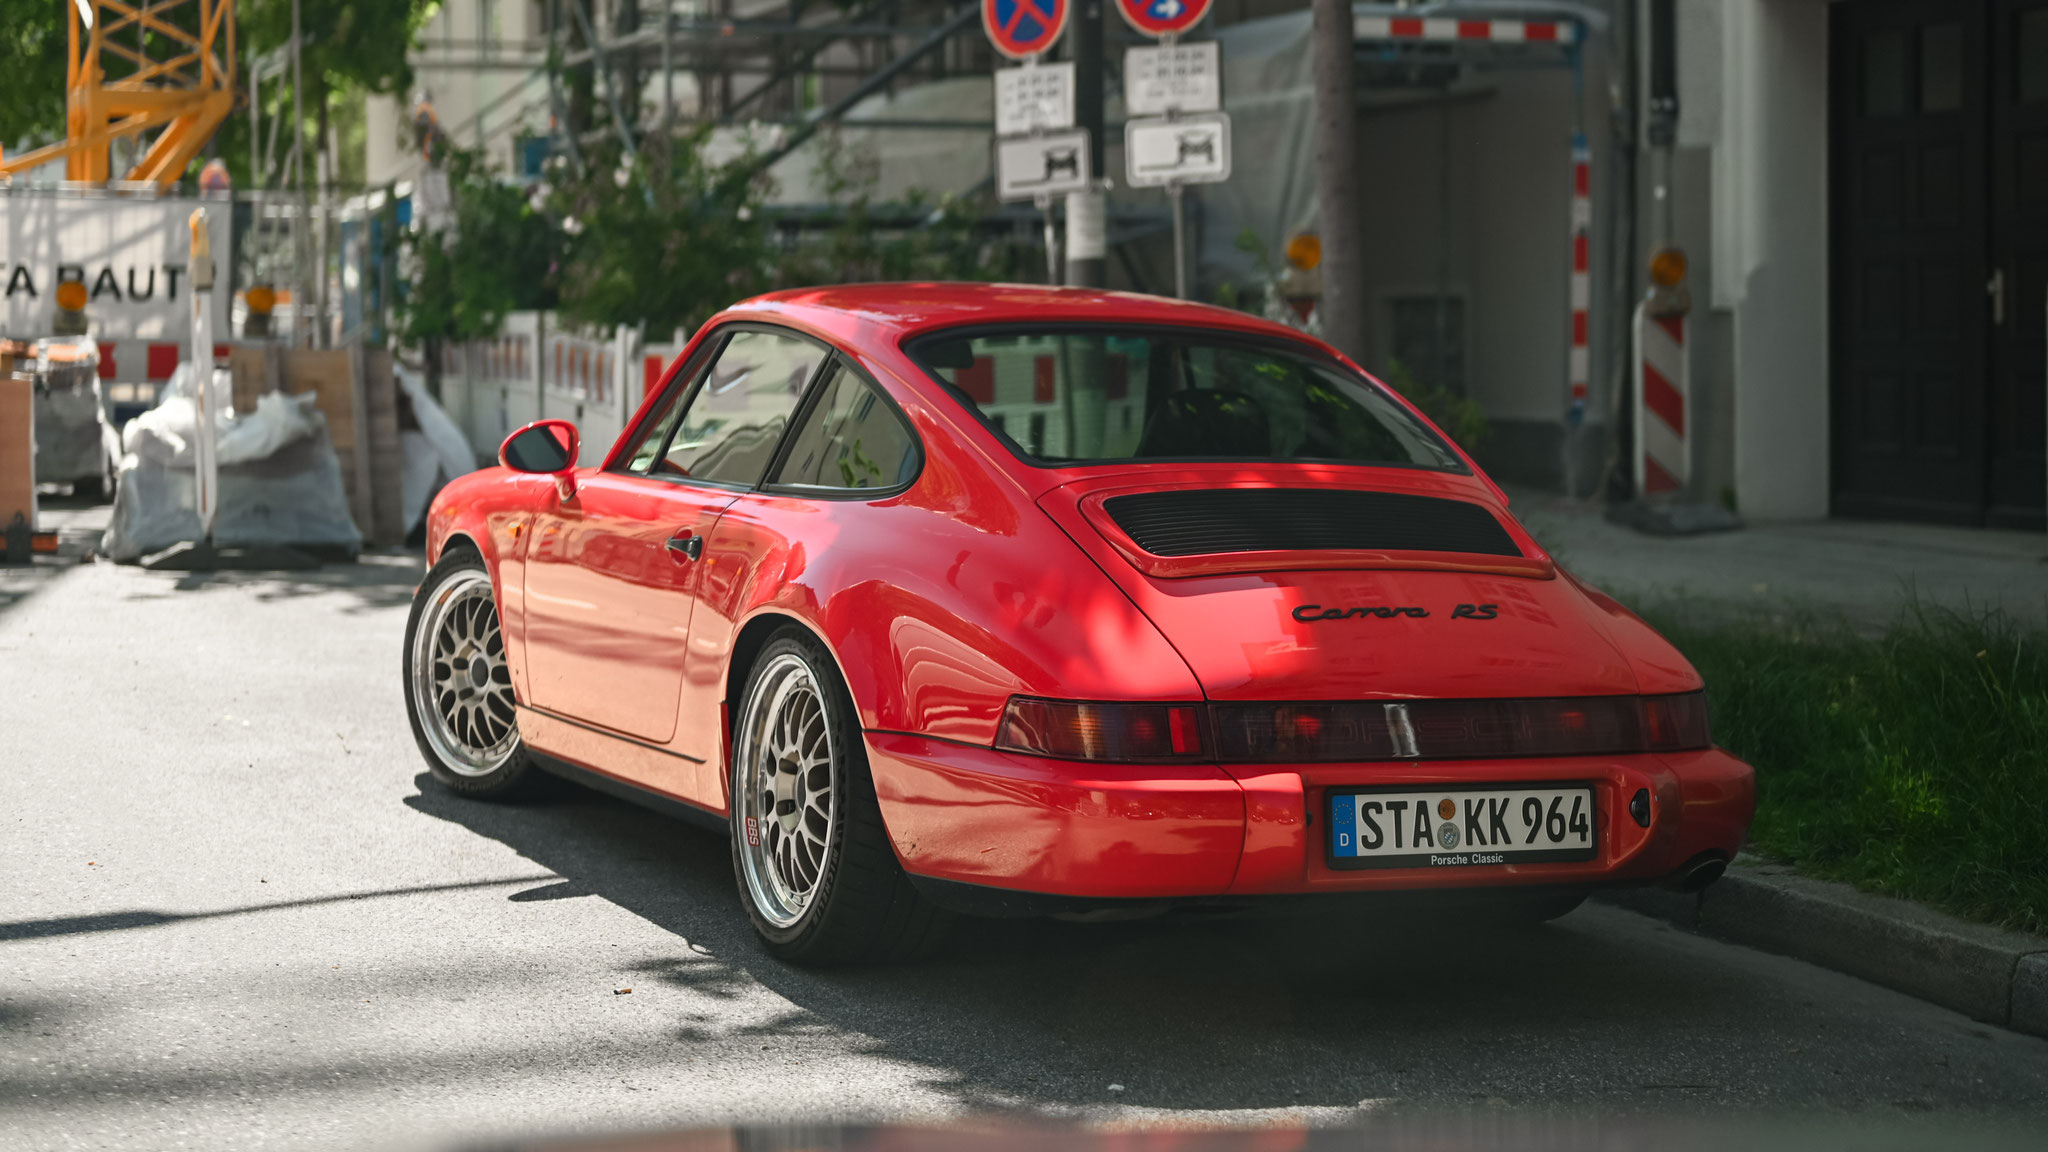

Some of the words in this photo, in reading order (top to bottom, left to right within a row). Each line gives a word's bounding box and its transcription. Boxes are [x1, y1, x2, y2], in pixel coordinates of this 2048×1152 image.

[0, 264, 37, 297] A
[1292, 605, 1430, 622] Carrera
[1451, 604, 1499, 620] RS
[747, 817, 759, 846] BBS
[1361, 800, 1434, 850] STA
[1464, 797, 1512, 846] KK
[1522, 795, 1588, 844] 964
[1340, 833, 1349, 847] D
[1431, 854, 1468, 865] Porsche
[1472, 853, 1504, 864] Classic
